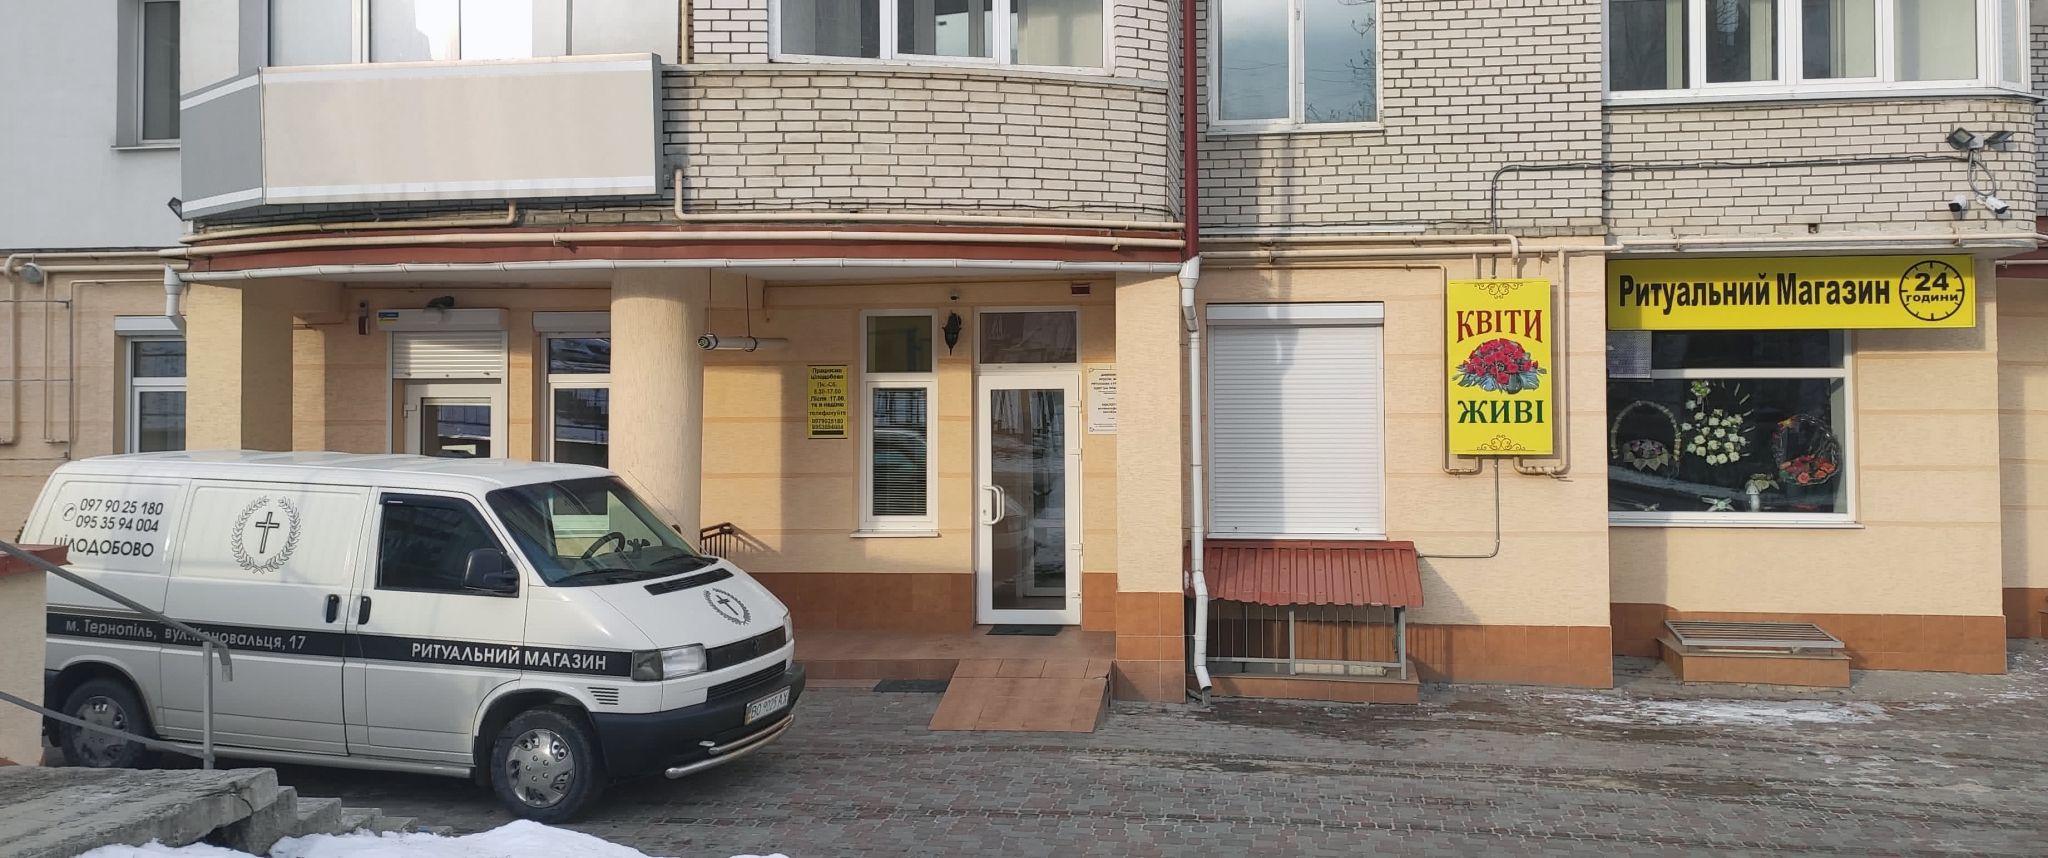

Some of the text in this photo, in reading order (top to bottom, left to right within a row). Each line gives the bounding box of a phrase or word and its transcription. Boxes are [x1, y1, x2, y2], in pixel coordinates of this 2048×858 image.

[1619, 272, 1890, 315] Ритуальний Магазин
[1915, 272, 1949, 291] 24
[1906, 294, 1959, 304] години
[1456, 309, 1543, 343] КВІТИ
[1457, 400, 1544, 424] ЖИВІ
[80, 499, 164, 515] 097 90 25 180
[75, 515, 159, 532] 095 35 94 004
[66, 620, 80, 632] м.
[84, 619, 157, 639] Тернопіль,
[290, 636, 306, 650] 17
[411, 643, 607, 670] РИТУАЛЬНИЙ МАГАЗИН
